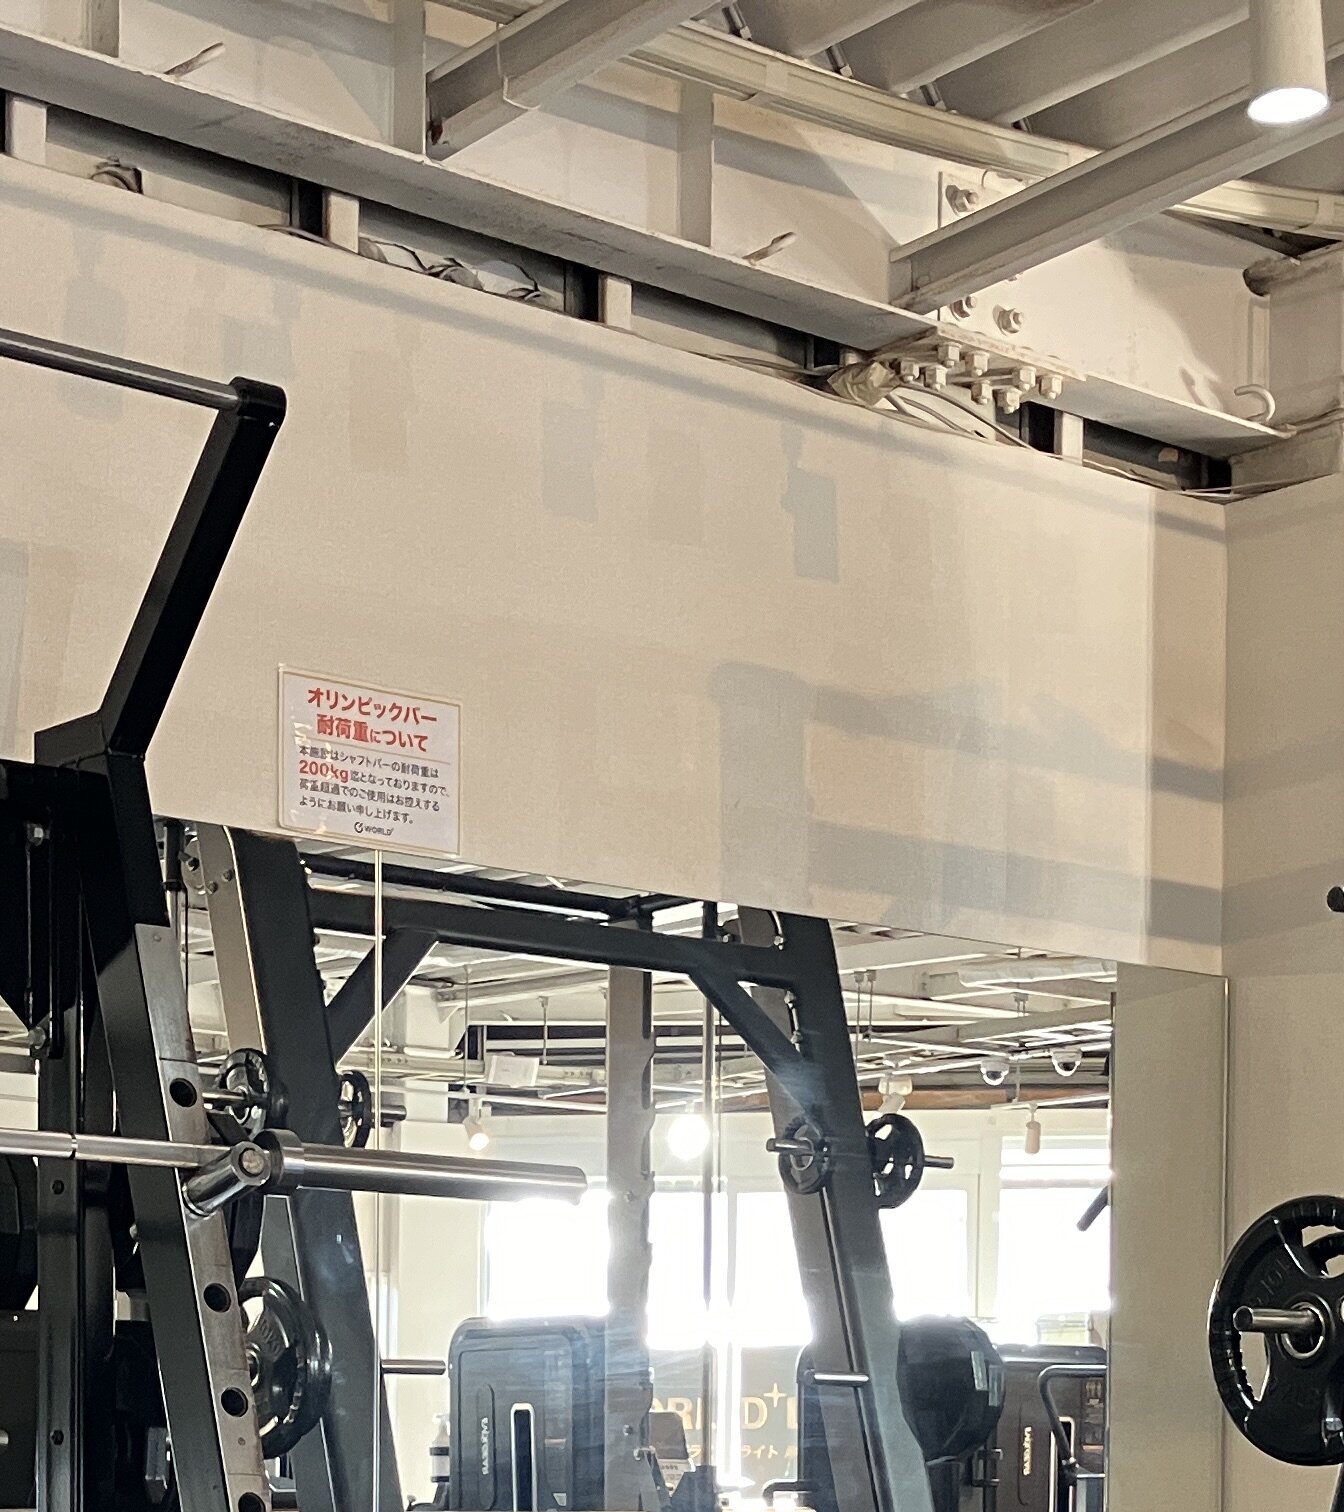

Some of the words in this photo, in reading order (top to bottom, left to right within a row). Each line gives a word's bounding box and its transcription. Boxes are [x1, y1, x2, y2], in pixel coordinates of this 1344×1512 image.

[307, 687, 437, 725] オリンピックバー
[316, 713, 429, 752] 耐荷重について
